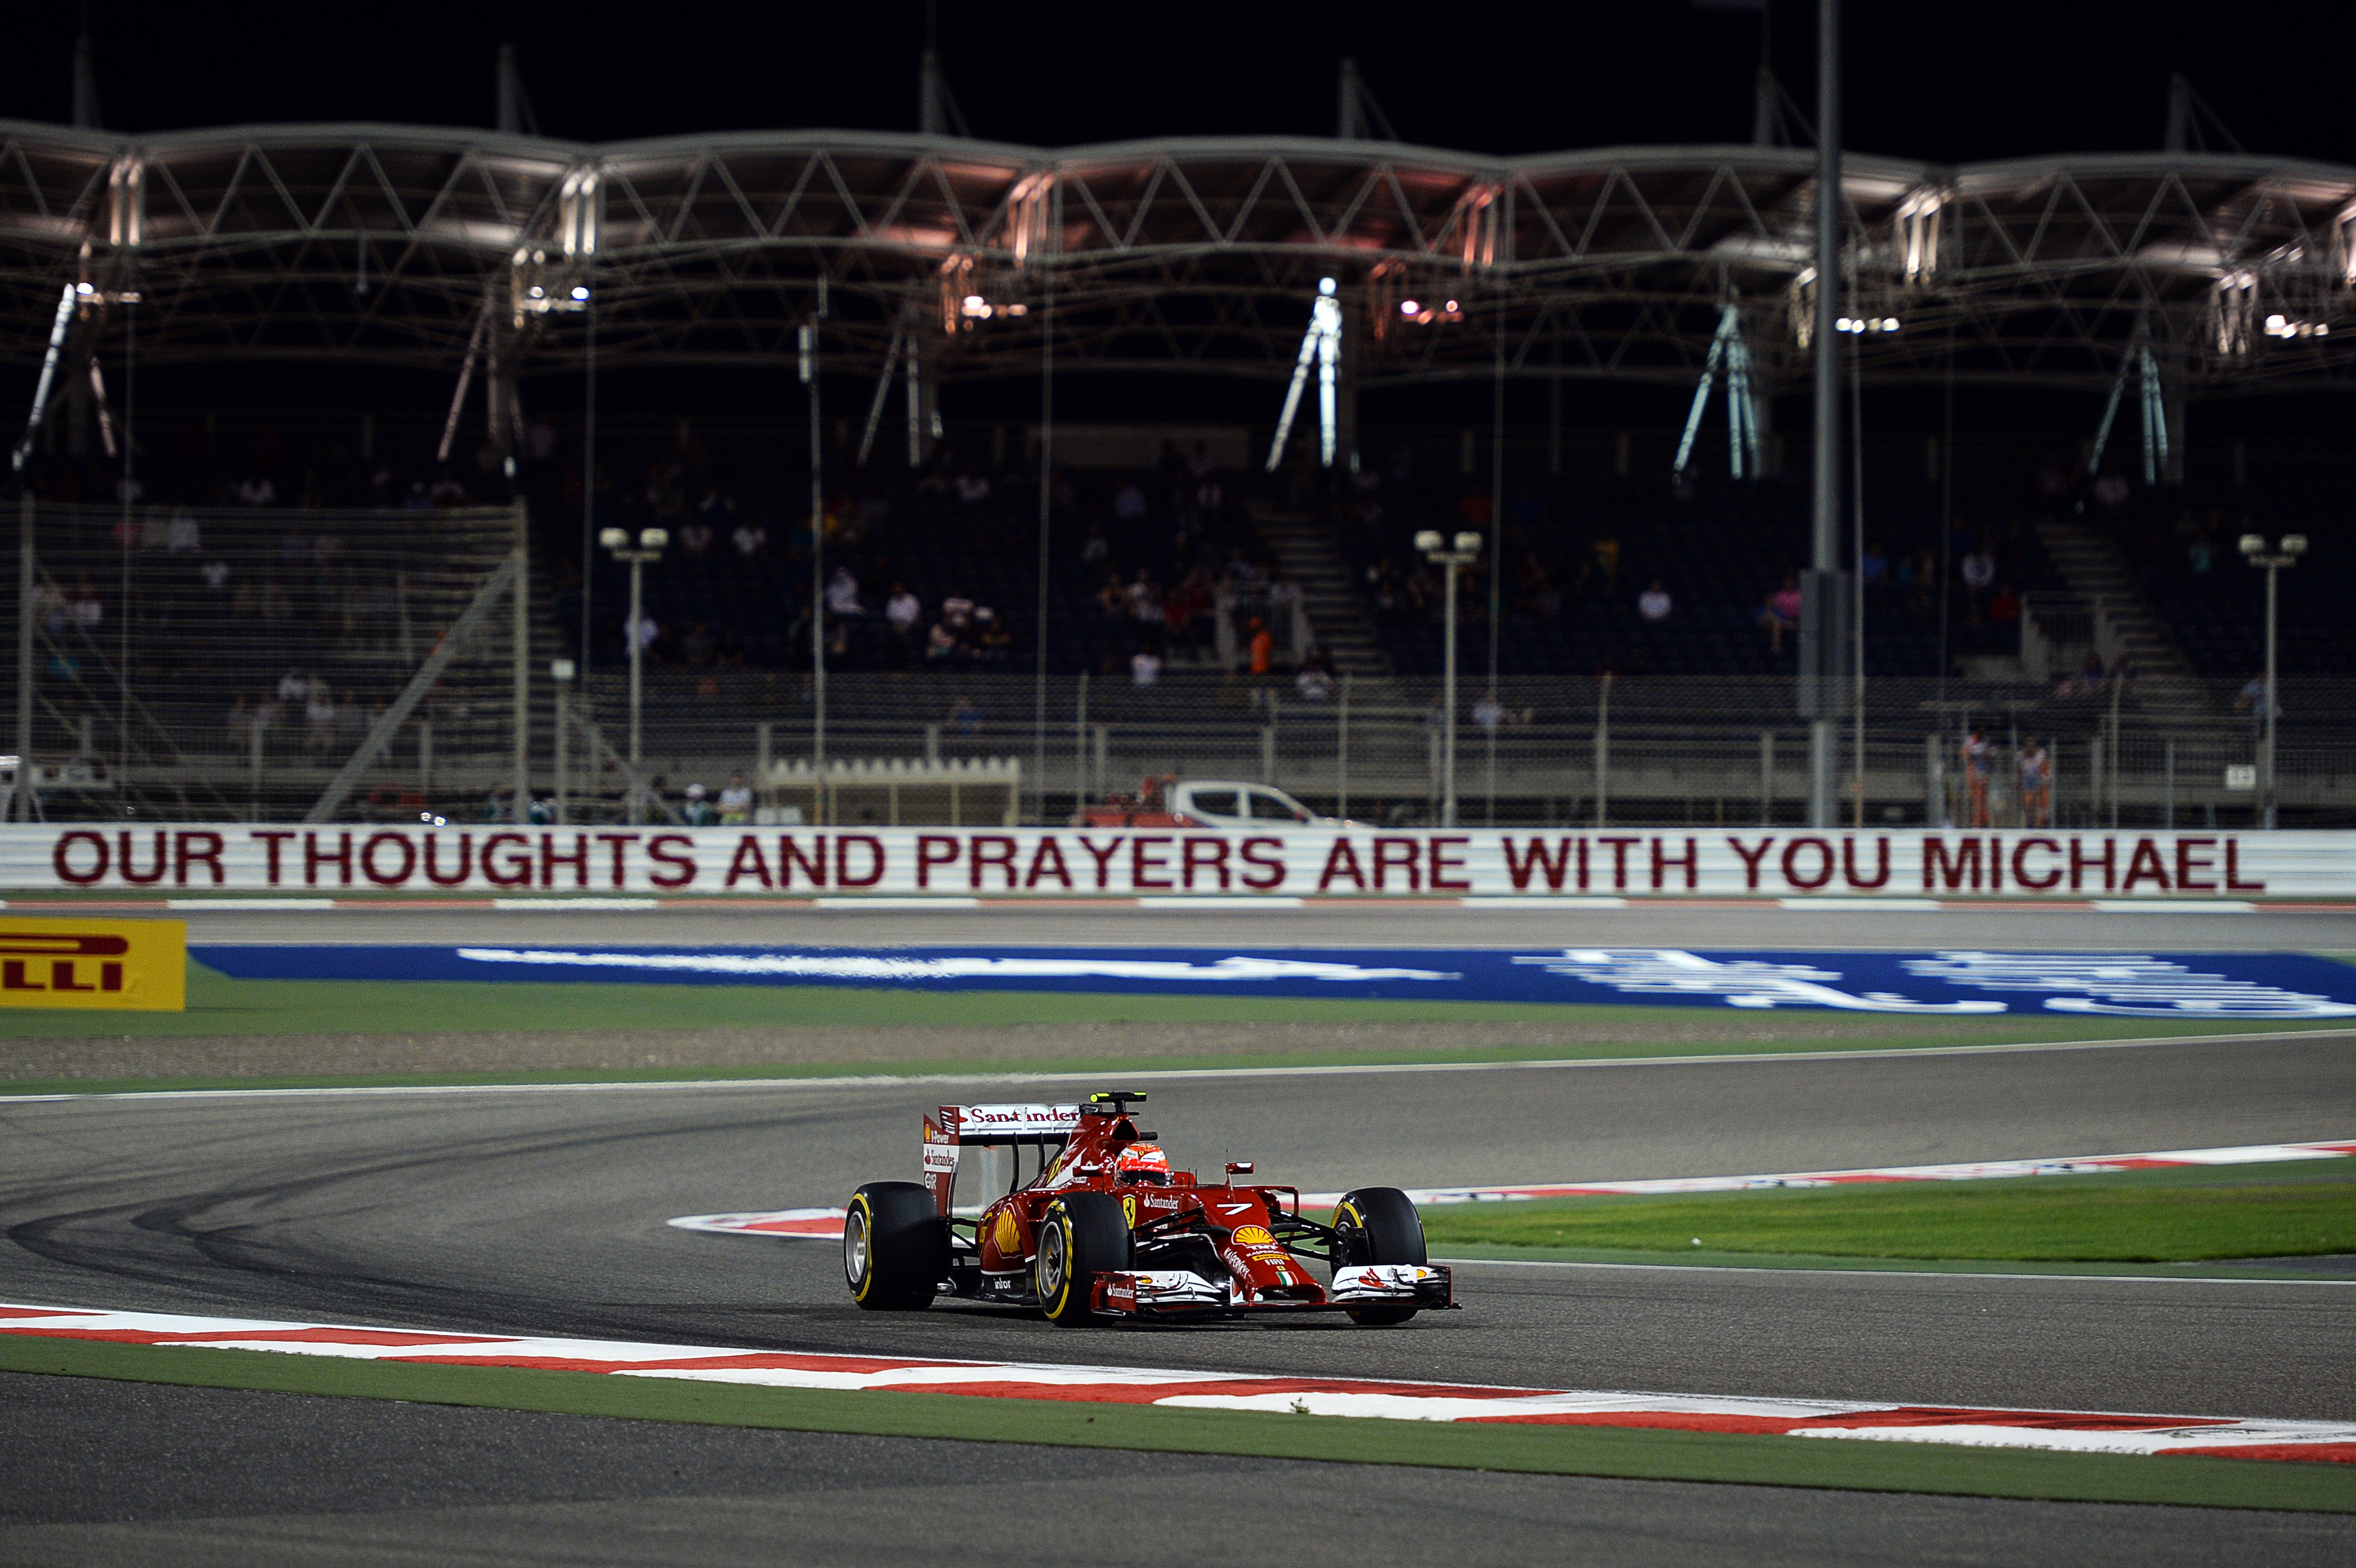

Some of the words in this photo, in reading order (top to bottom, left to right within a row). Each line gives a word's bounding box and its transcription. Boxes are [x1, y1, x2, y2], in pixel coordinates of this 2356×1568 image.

[55, 831, 224, 885] OUR
[252, 833, 696, 888] THOUGHTS
[726, 836, 884, 888] AND
[917, 836, 1285, 890] PRAYERS
[1319, 838, 1469, 890] ARE
[1503, 838, 1696, 890] WITH
[1729, 838, 1888, 891] YOU
[1923, 838, 2265, 891] MICHAEL
[930, 1130, 949, 1143] V-Power
[1150, 1194, 1178, 1209] Santander
[1216, 1203, 1254, 1215] 7
[1224, 1247, 1250, 1279] KASPERSKY
[993, 1277, 1012, 1289] infor
[1113, 1283, 1134, 1299] Santander
